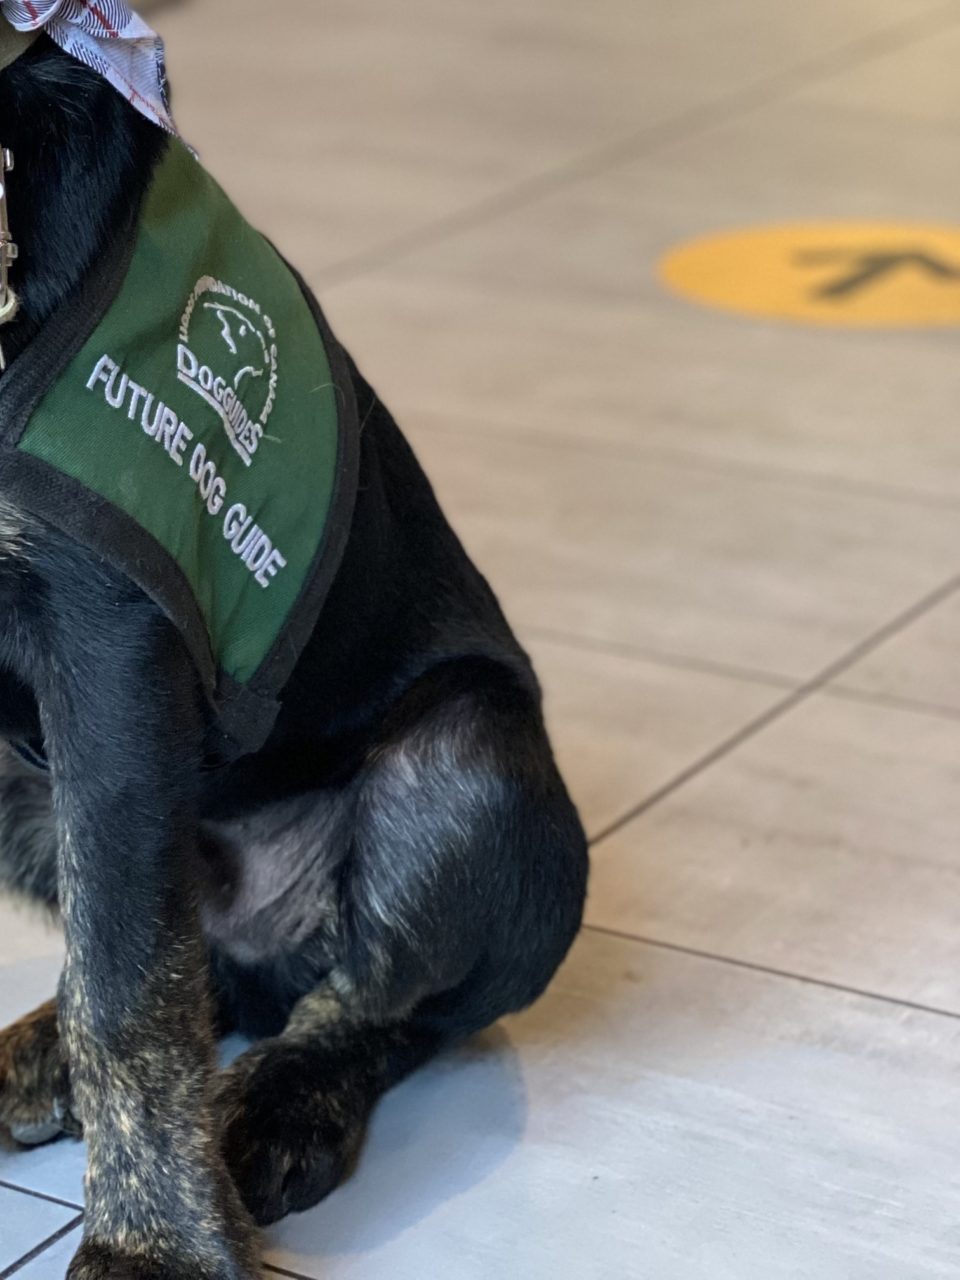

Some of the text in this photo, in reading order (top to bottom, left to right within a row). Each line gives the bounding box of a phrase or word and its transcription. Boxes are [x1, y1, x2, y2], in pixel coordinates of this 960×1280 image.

[86, 354, 287, 588] FUTURE DOG GUIDE
